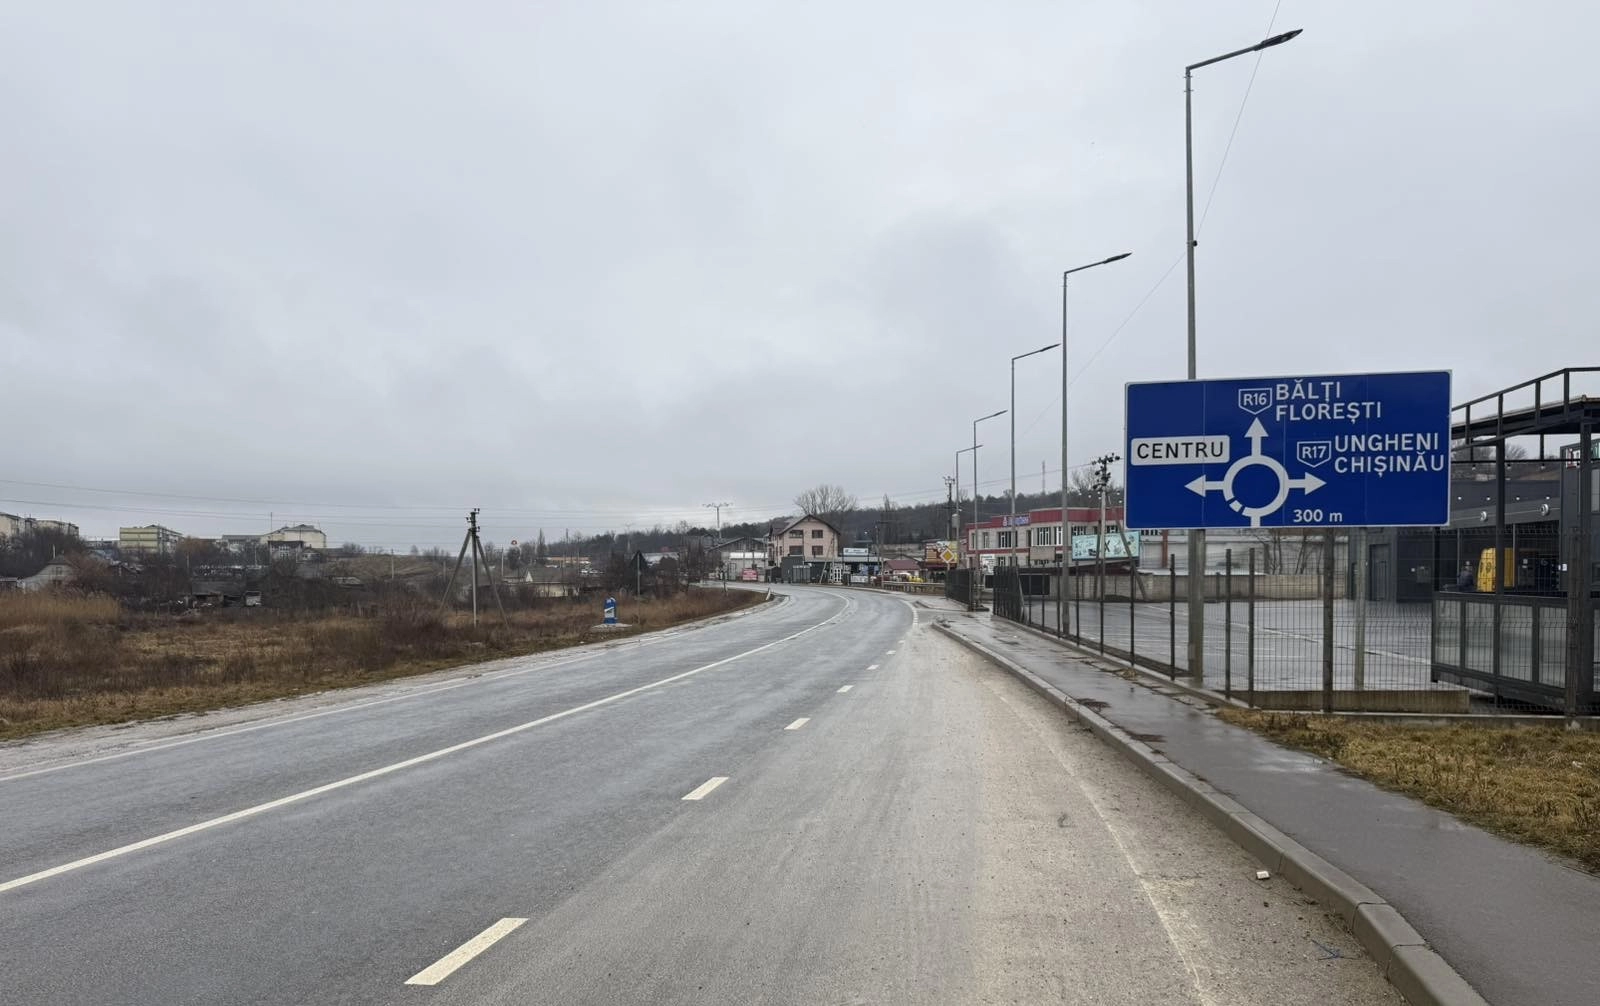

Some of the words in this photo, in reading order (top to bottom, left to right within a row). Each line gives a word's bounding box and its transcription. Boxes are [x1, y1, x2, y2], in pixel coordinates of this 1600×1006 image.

[1243, 392, 1267, 406] R16
[1276, 379, 1341, 402] BĂLȚI
[1276, 401, 1382, 424] FLOREȘTI
[1136, 440, 1225, 460] CENTRU
[1302, 445, 1327, 459] R17
[1335, 432, 1439, 453] UNGHENI
[1334, 451, 1445, 476] CHIȘINĂU
[1293, 509, 1323, 523] 300
[1329, 512, 1343, 522] m
